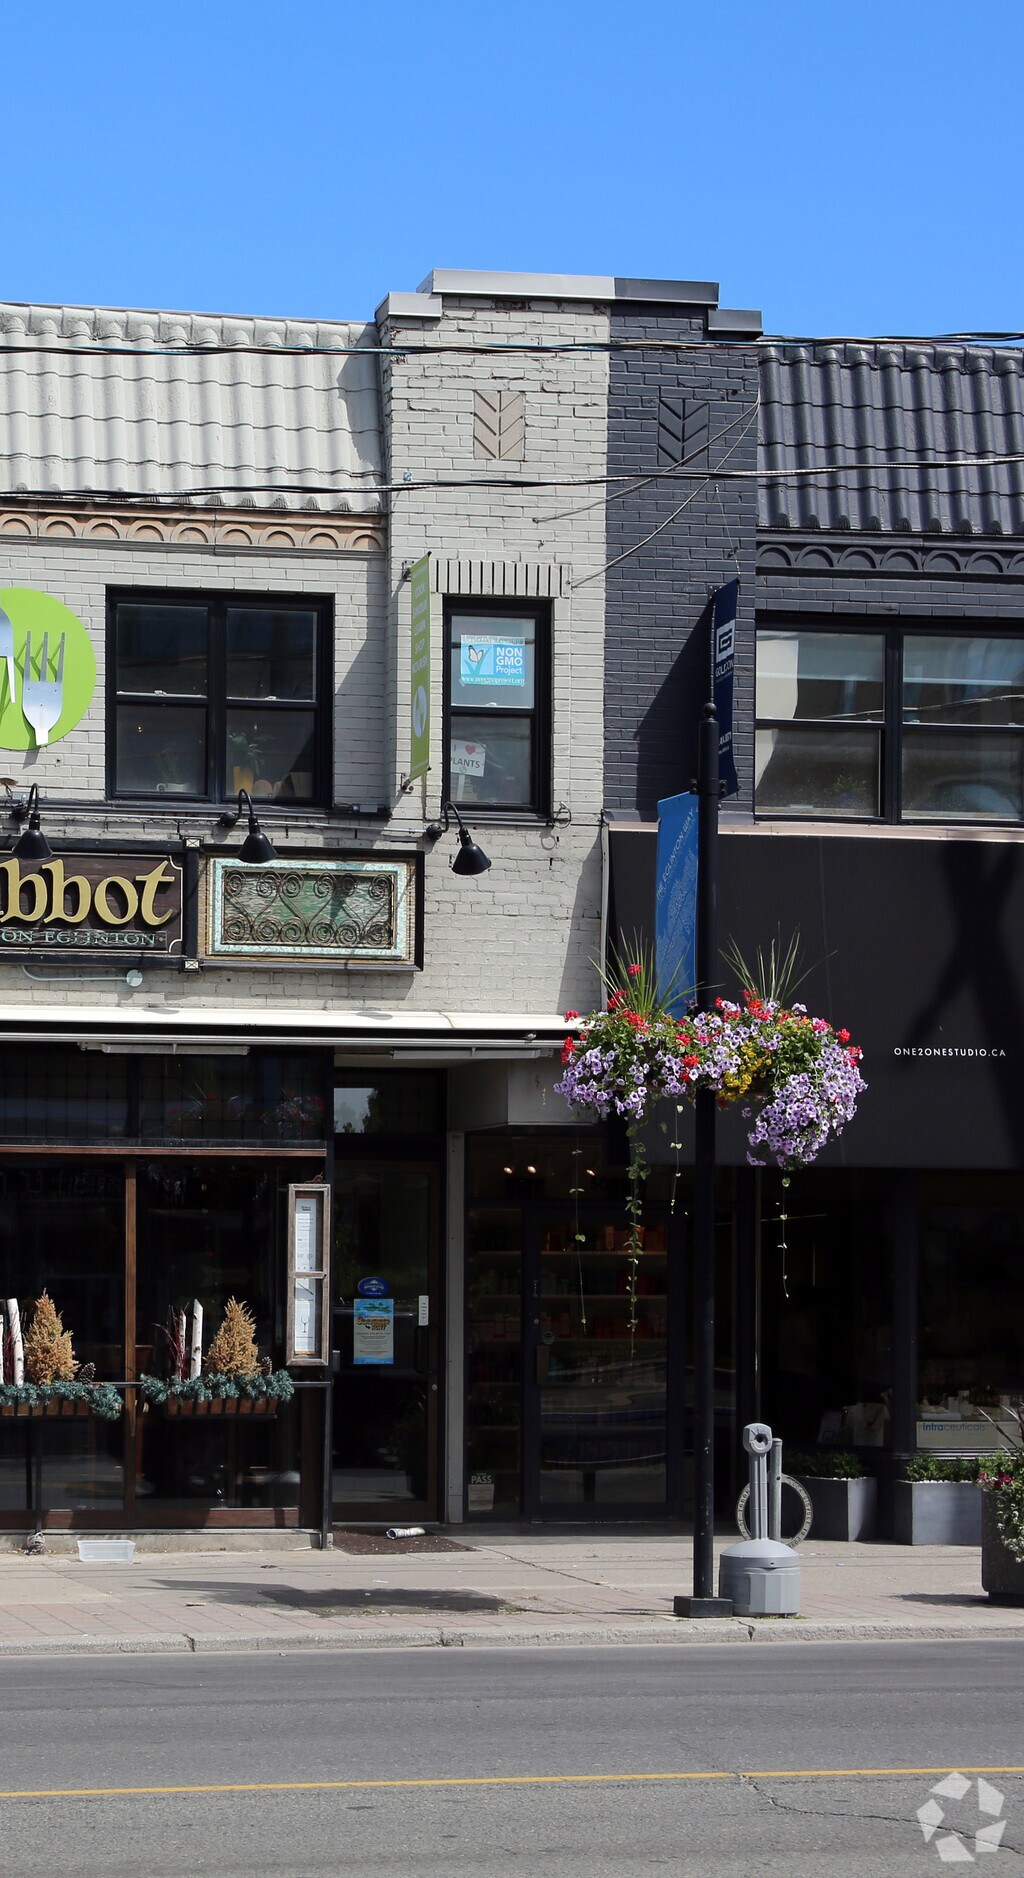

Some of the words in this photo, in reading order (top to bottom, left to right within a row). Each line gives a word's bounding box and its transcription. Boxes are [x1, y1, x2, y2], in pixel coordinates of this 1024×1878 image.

[496, 647, 523, 657] NON
[496, 656, 523, 666] GMO
[496, 666, 522, 676] Project
[662, 831, 684, 881] EGLINTON
[682, 807, 694, 833] WAY
[1, 930, 34, 943] ON
[44, 930, 157, 946] EGLINTON
[893, 1047, 1007, 1057] ONE2ONESTUDIO.CA
[922, 1422, 986, 1432] intraceuticals
[471, 1475, 492, 1484] PASS
